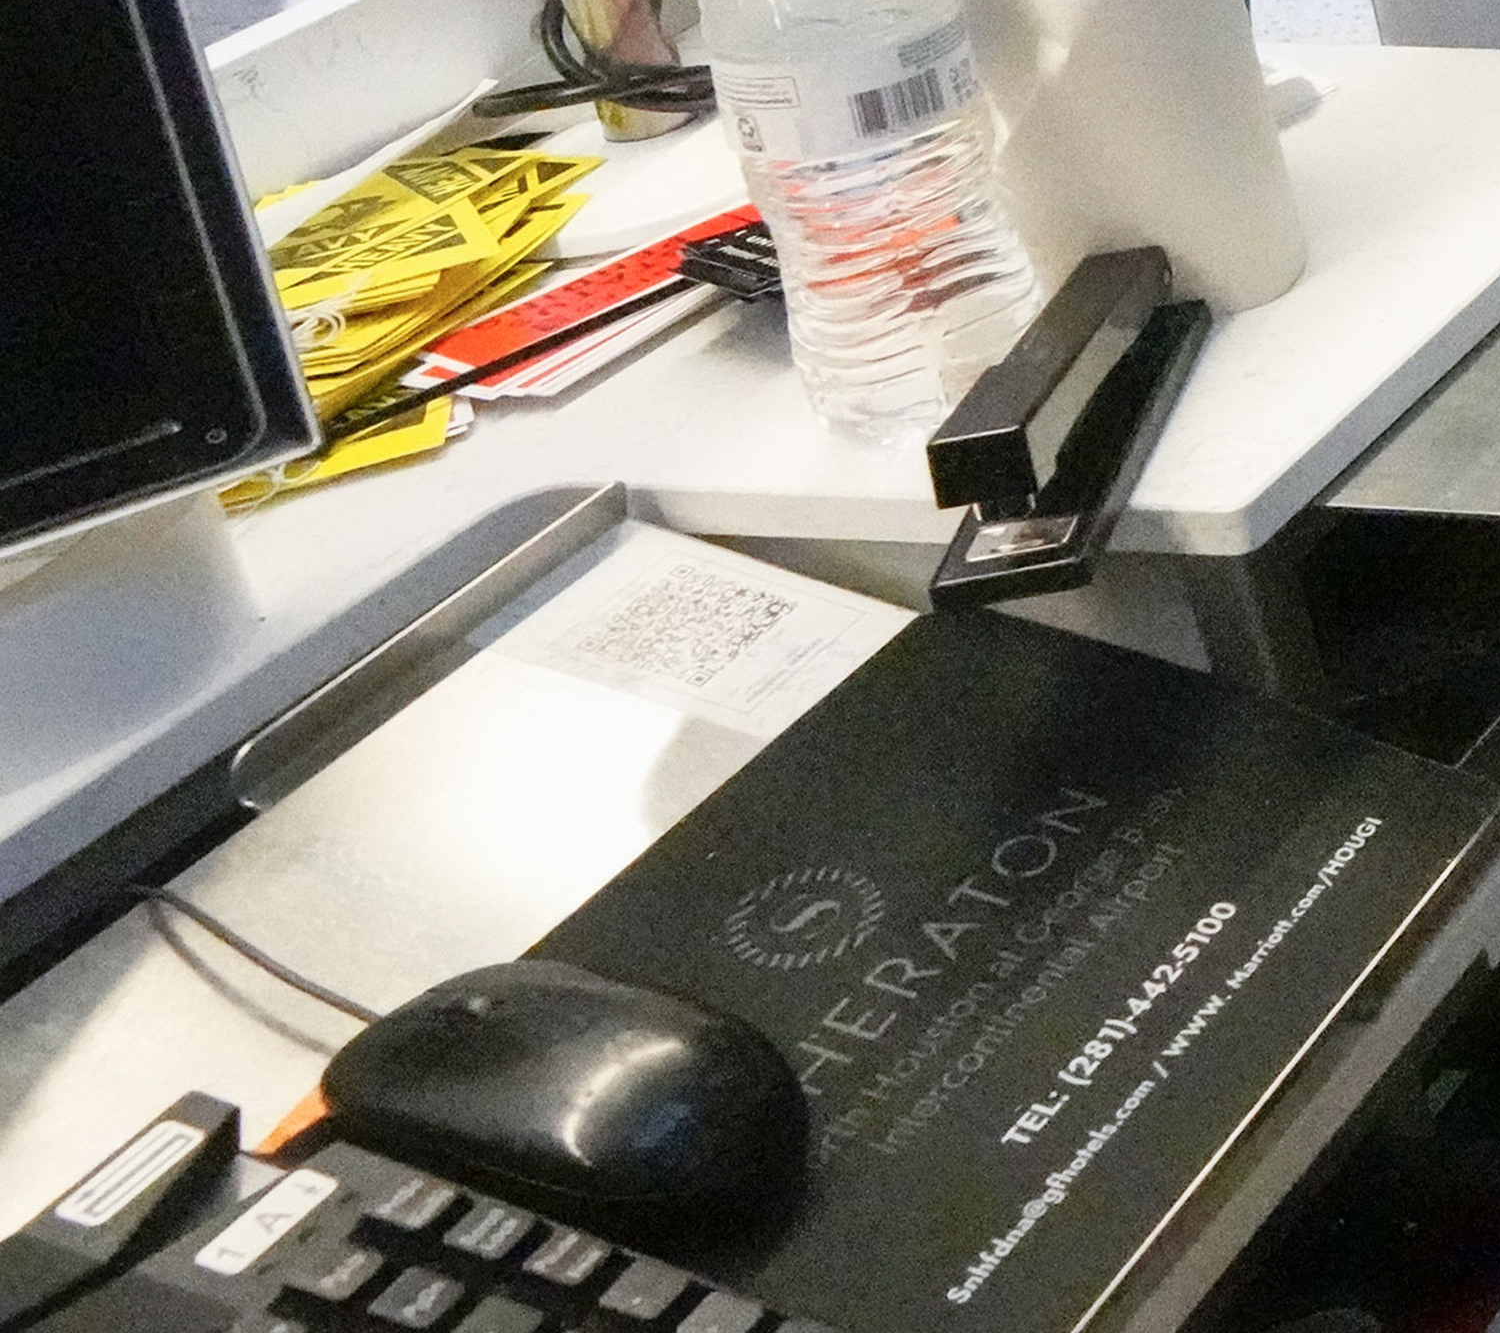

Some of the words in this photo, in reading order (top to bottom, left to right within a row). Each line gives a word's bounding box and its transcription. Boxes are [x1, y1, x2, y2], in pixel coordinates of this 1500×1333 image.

[800, 788, 1107, 1096] HERATON
[1001, 1090, 1070, 1145] TEL:
[1057, 901, 1237, 1086] (281)-442-5100
